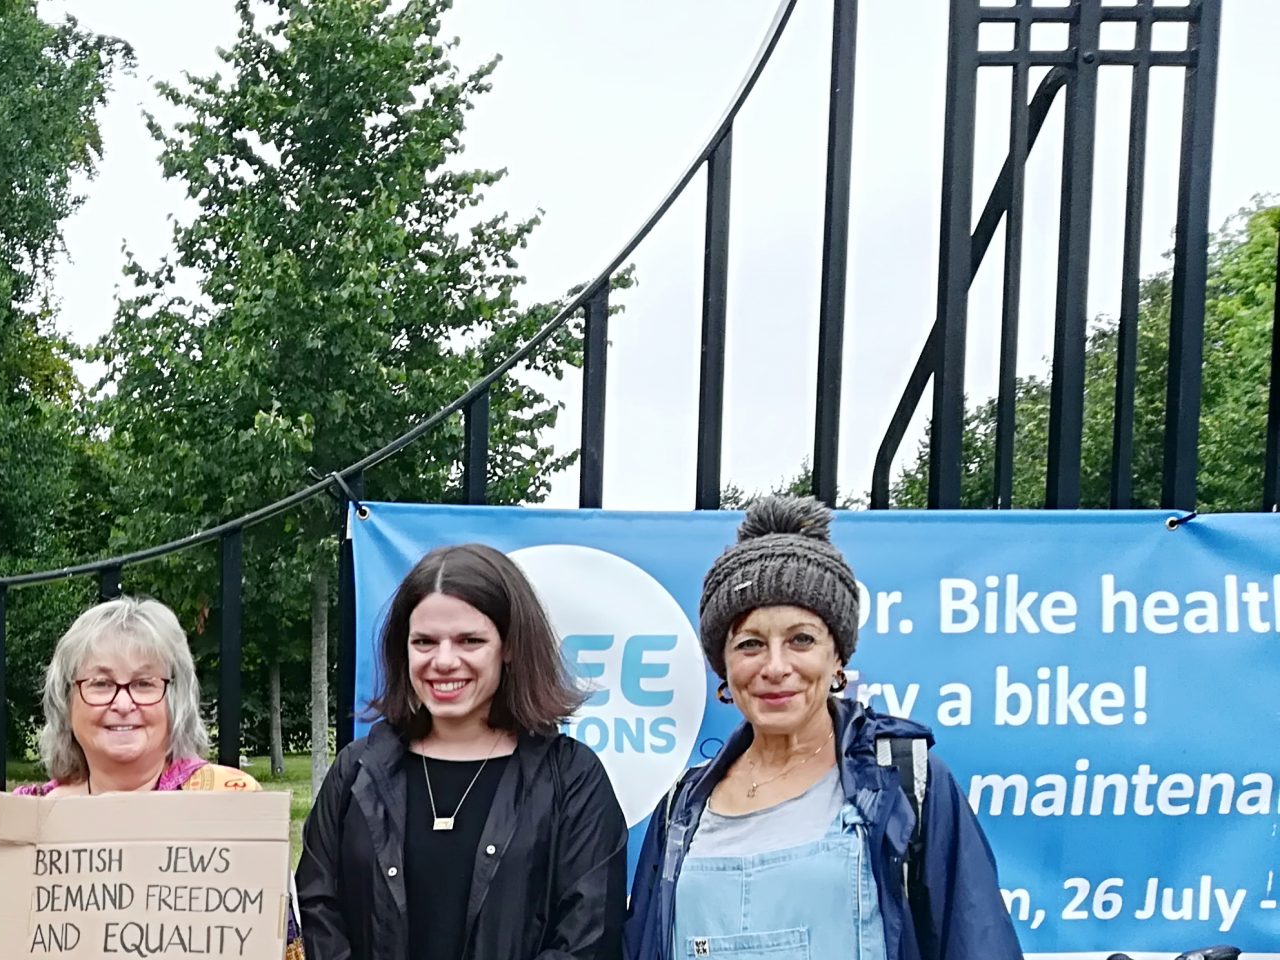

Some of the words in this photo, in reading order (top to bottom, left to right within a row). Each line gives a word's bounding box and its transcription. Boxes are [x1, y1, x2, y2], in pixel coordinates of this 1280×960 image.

[938, 574, 1078, 635] Bike
[1101, 574, 1280, 634] healt
[837, 670, 920, 719] ry
[937, 681, 973, 726] a
[994, 665, 1148, 726] bike!
[968, 758, 1280, 816] maintena
[32, 848, 123, 876] BRITISH
[158, 846, 231, 873] JEWS
[35, 883, 134, 912] DEMAND
[145, 884, 264, 914] FREEDOM
[1061, 877, 1124, 920] 26
[1133, 875, 1247, 932] July
[30, 923, 80, 953] AND
[103, 921, 253, 958] EQUALITY
